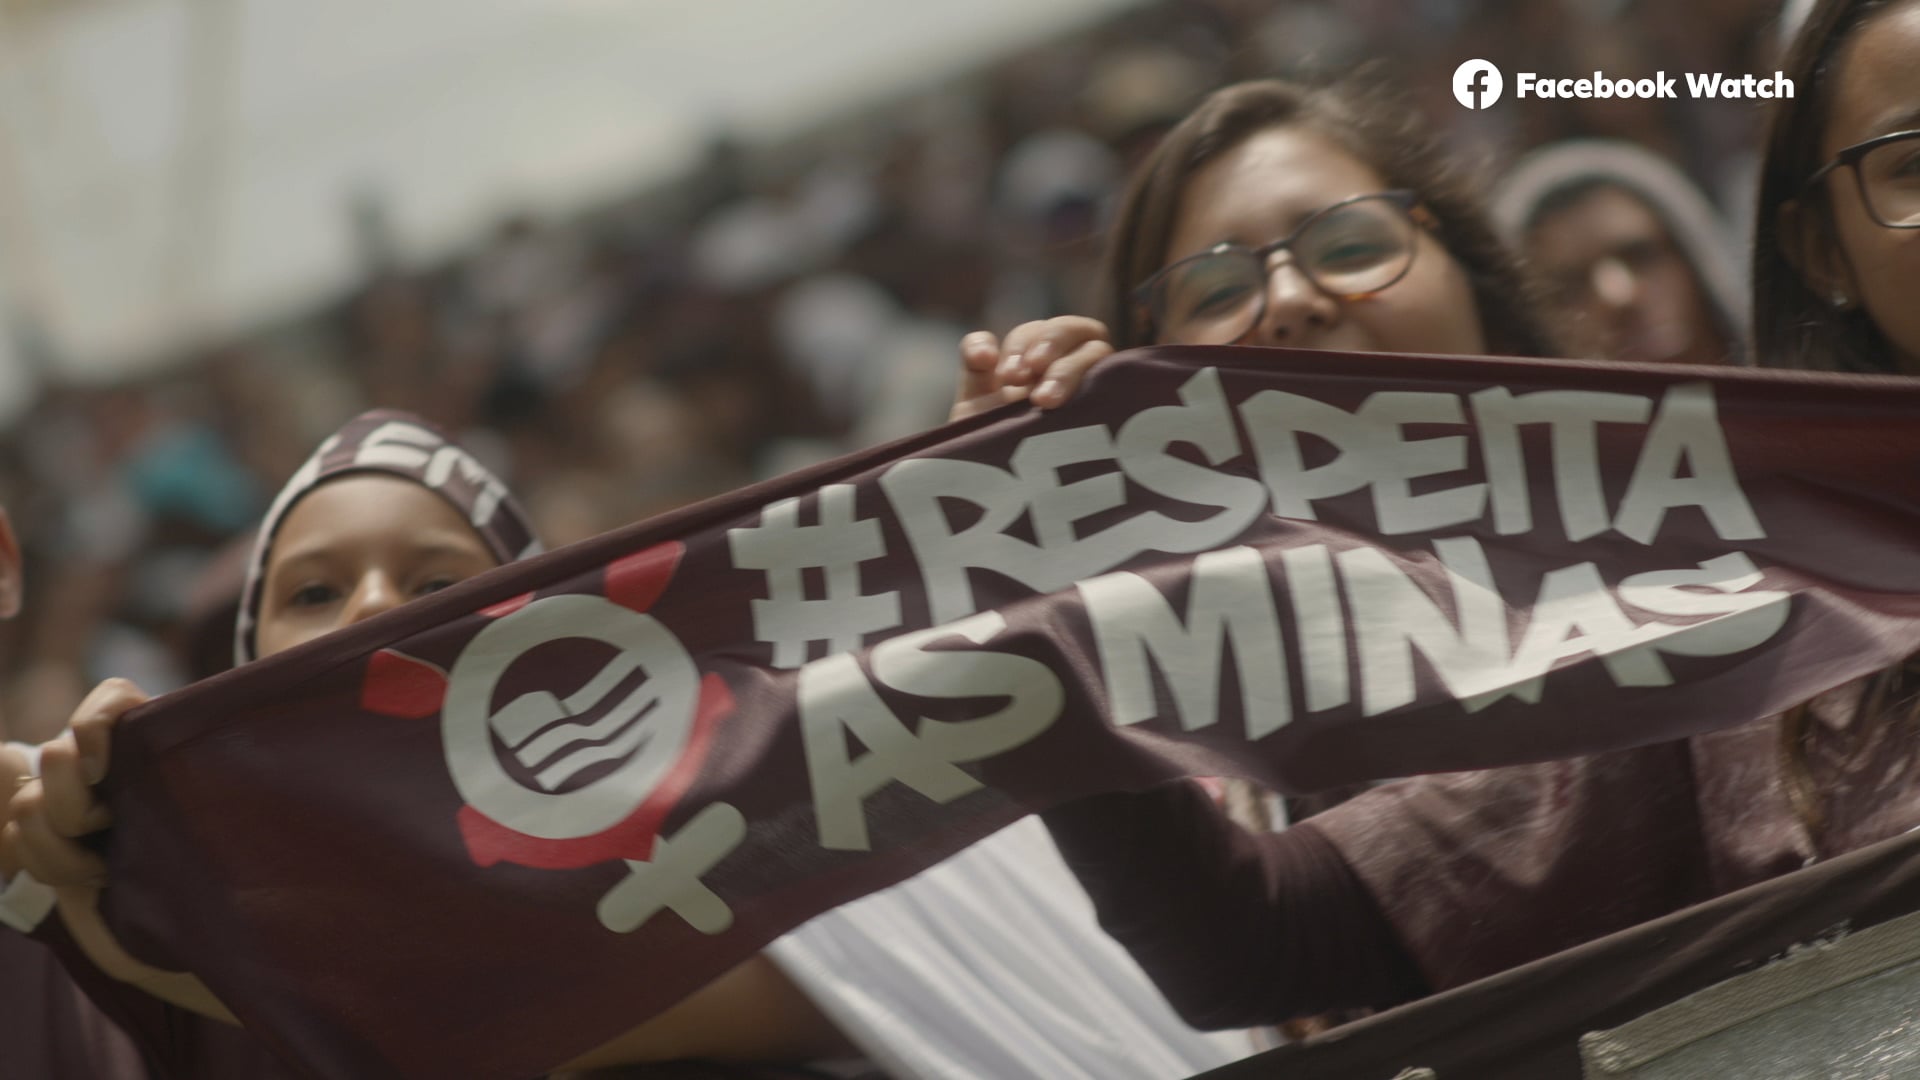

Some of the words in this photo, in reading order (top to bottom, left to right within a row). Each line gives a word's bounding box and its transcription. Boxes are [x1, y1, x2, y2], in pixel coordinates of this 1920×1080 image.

[728, 367, 1766, 668] #RESPEITA
[797, 610, 1065, 850] AS
[1075, 537, 1790, 740] MINAS
